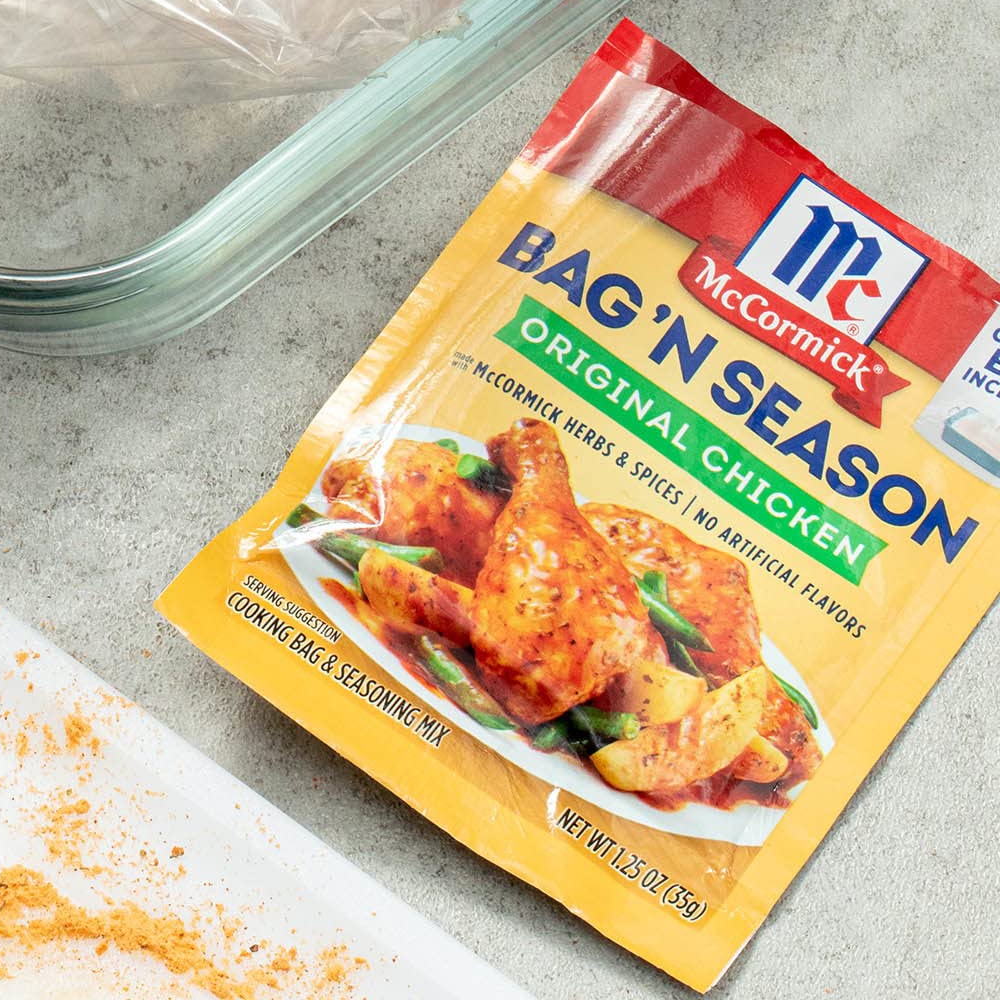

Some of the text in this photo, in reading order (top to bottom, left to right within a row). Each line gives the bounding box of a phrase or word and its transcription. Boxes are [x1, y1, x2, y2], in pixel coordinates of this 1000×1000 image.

[452, 360, 469, 371] with
[454, 351, 475, 364] made
[496, 221, 644, 329] BAG
[711, 360, 980, 564] SEASON
[472, 361, 867, 640] McCORMICK HERBS & SPICES NO ARTIFICIAL FLAVORS
[520, 317, 866, 567] ORIGINAL CHICKEN
[227, 592, 451, 747] COOKING BAG & SEASONING MIX
[243, 575, 342, 643] SERVING SUGGESTION
[556, 808, 708, 921] NET WT 1.25 OZ (35g)
